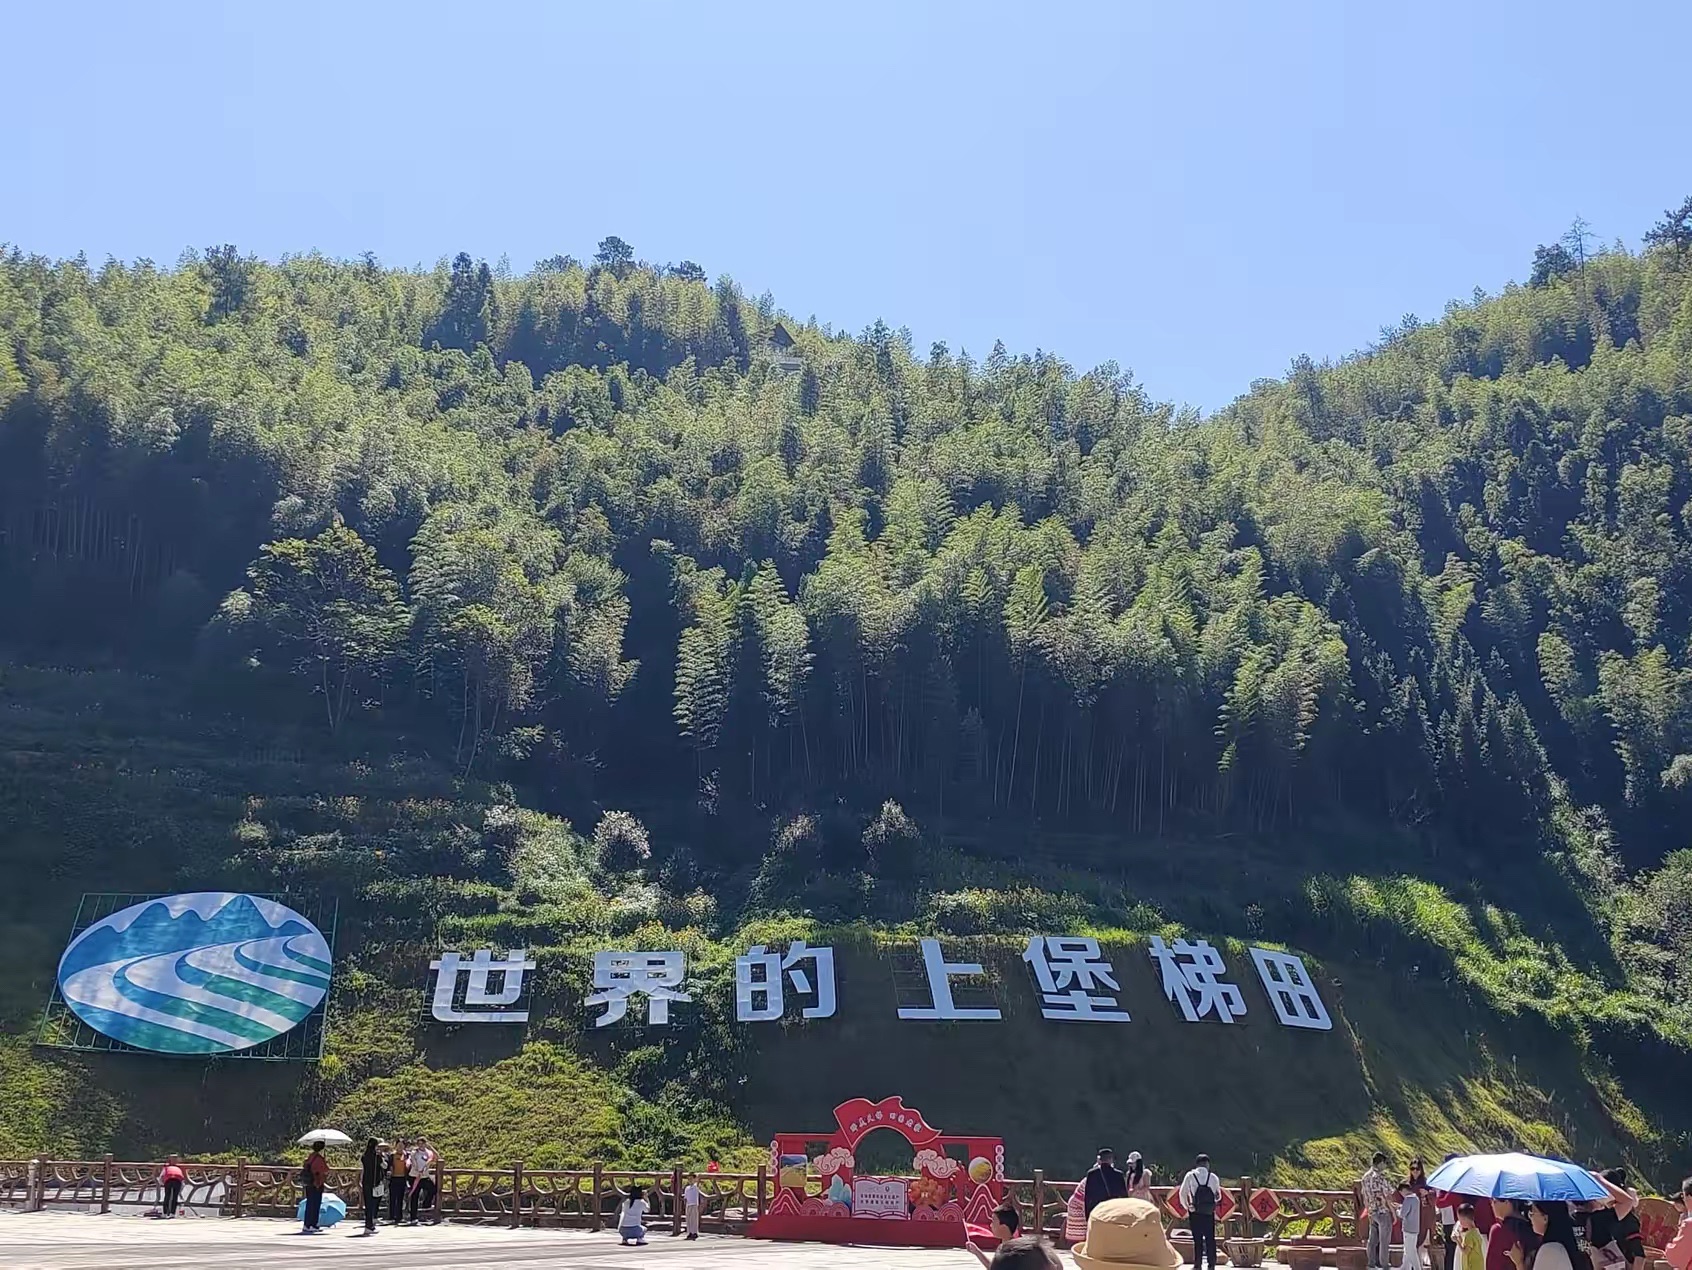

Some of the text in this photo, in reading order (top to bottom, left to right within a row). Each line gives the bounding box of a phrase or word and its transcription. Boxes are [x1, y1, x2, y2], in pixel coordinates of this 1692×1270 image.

[429, 934, 1333, 1030] 世界的上堡梯田
